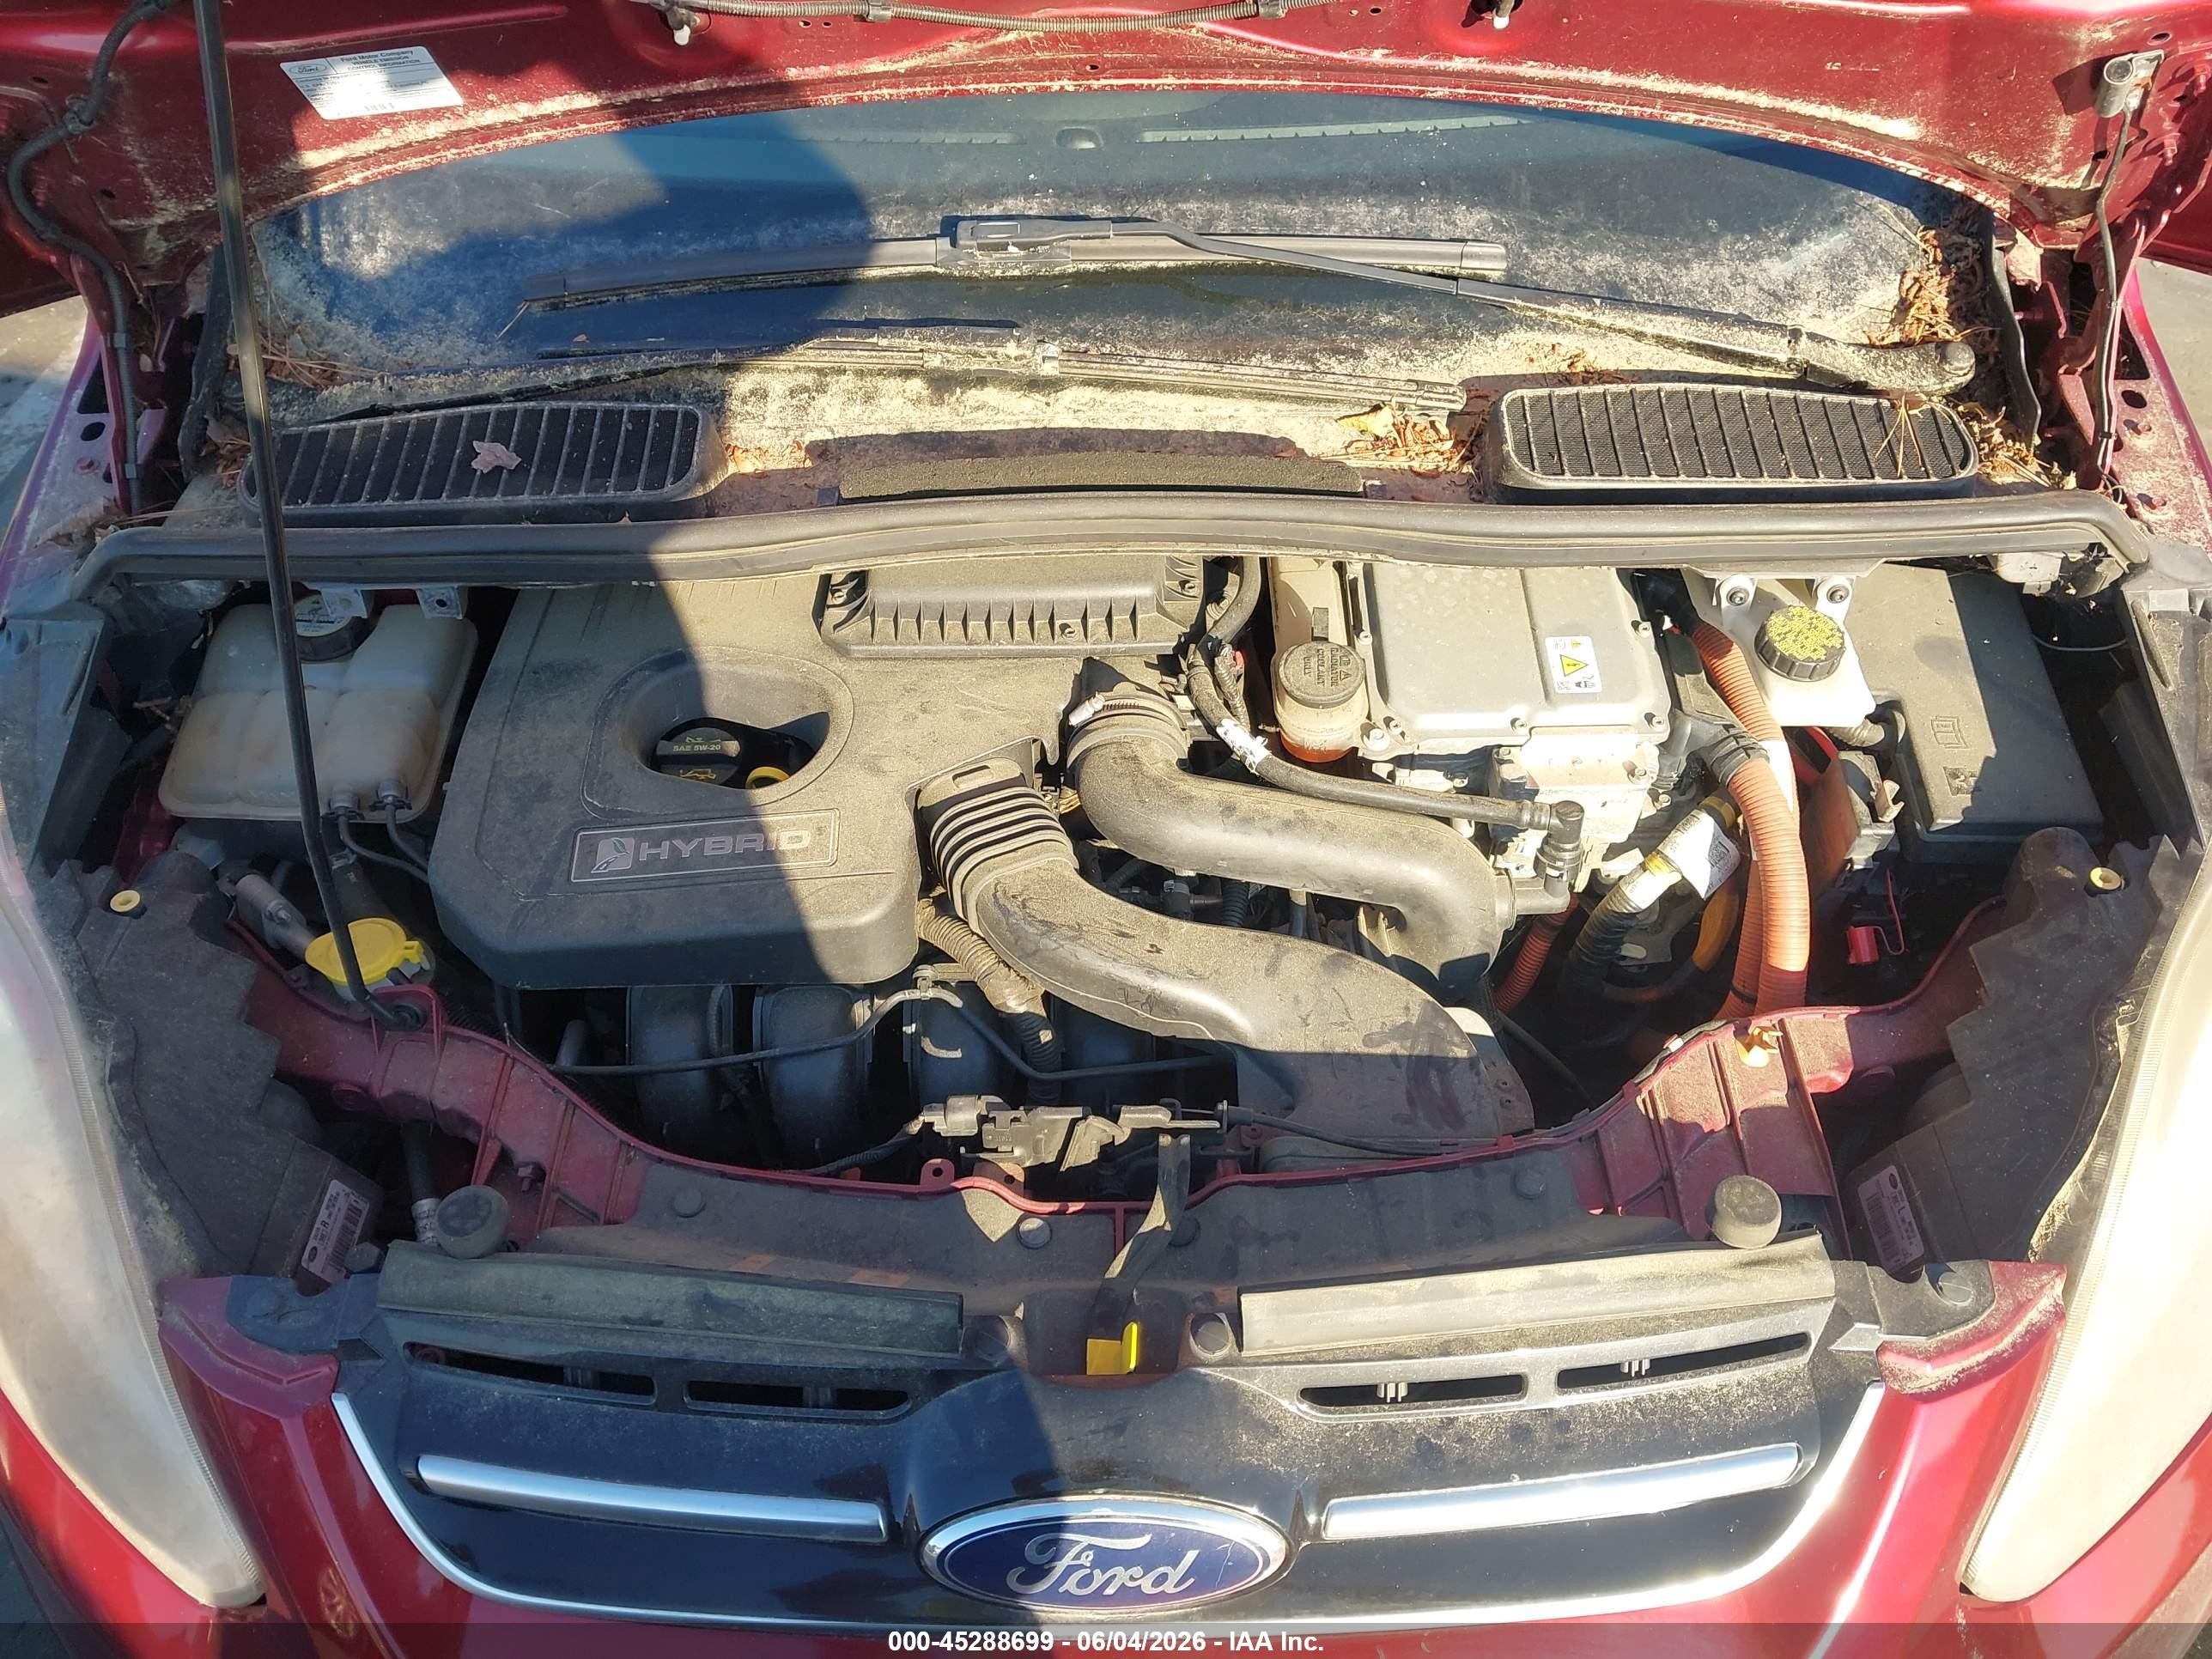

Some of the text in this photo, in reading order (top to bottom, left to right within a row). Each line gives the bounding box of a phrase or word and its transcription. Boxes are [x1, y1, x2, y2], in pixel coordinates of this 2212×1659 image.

[672, 744, 722, 752] SAE 5W-20
[638, 829, 811, 862] HYBRID
[1006, 1532, 1199, 1596] Ford
